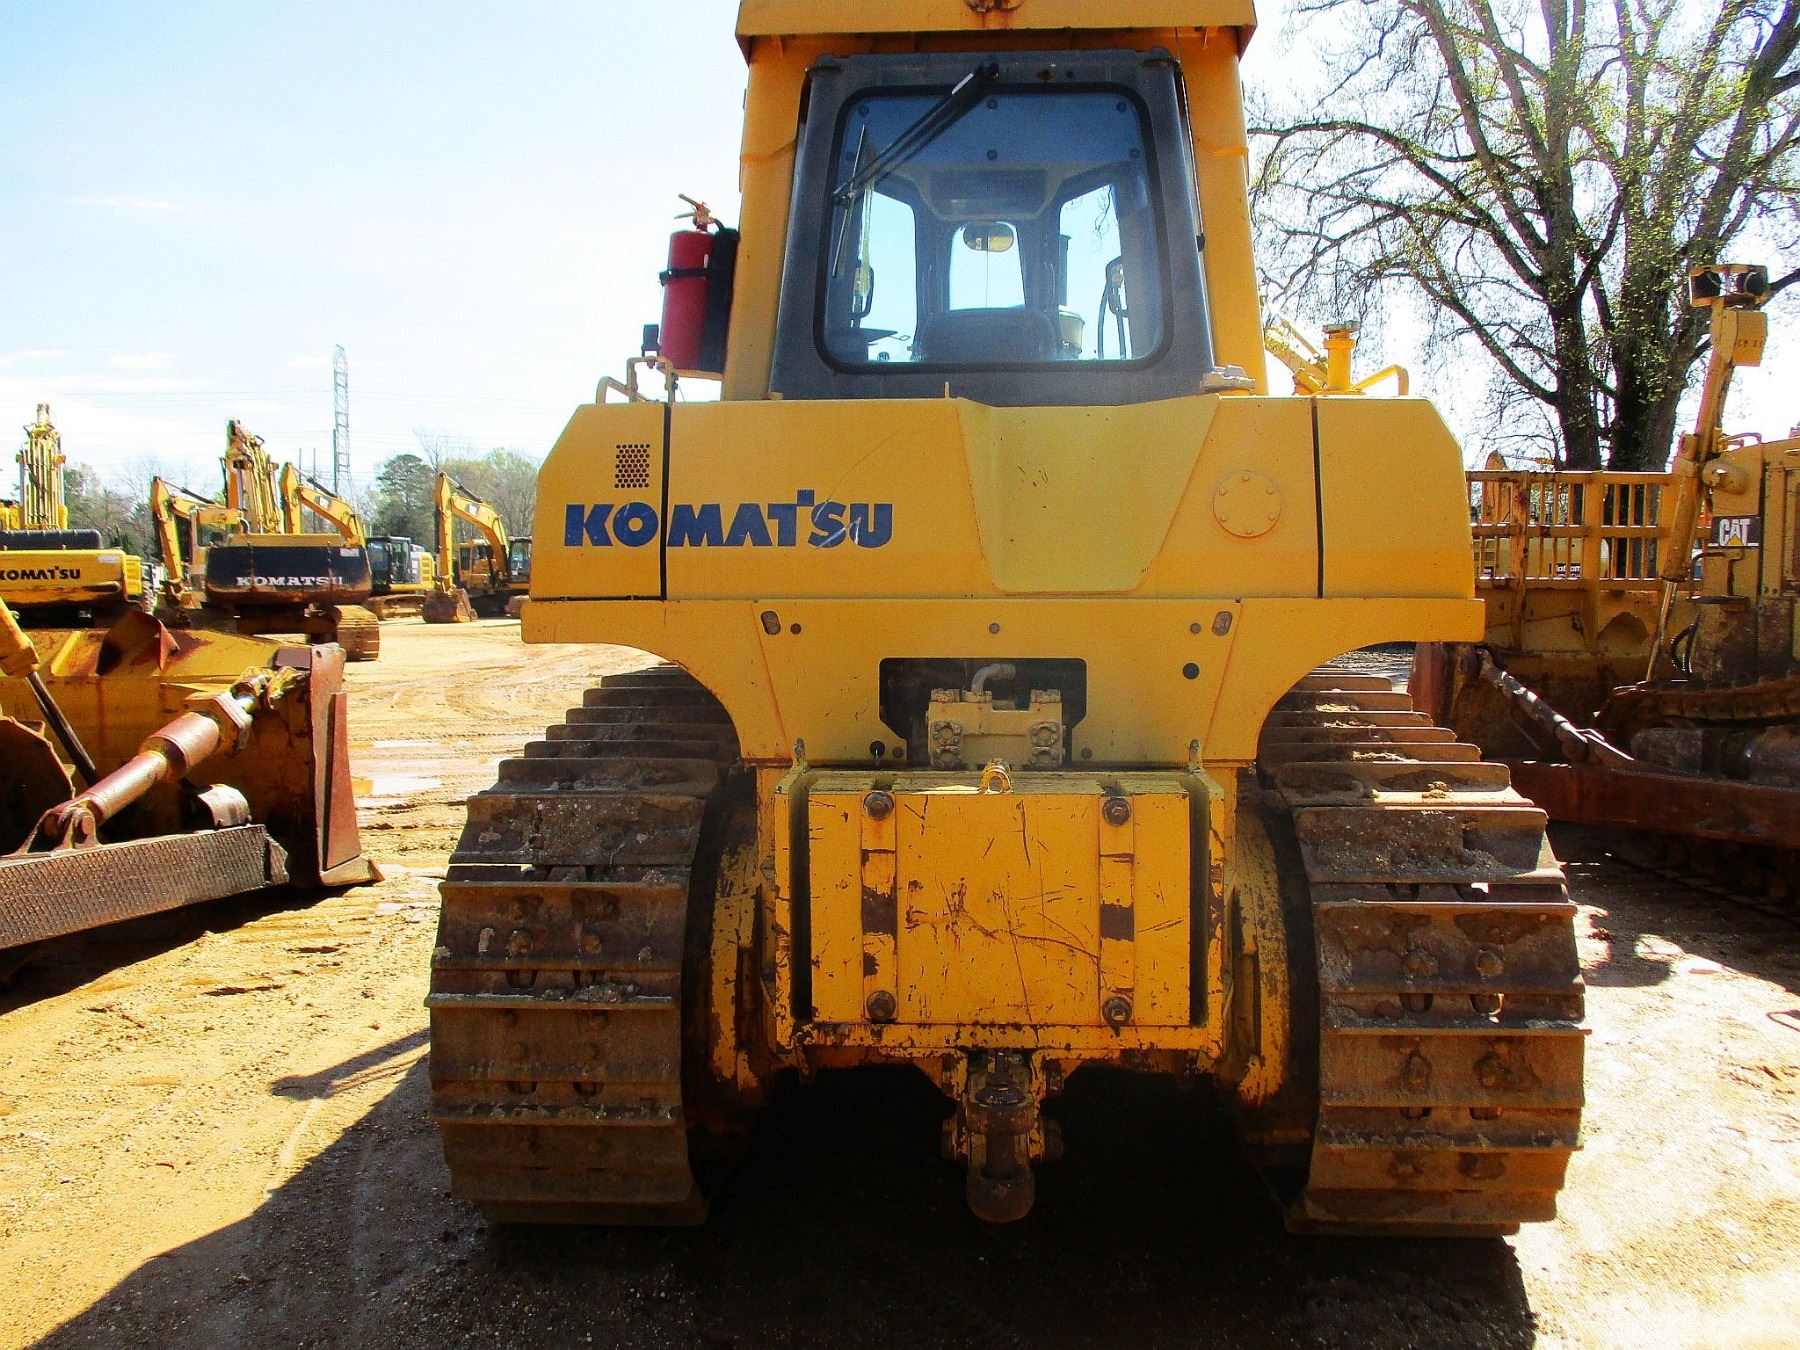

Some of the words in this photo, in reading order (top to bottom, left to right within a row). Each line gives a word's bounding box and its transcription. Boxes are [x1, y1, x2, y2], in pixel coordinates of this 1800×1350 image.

[564, 489, 893, 548] KOMATSU
[1720, 518, 1751, 547] CAT
[236, 576, 343, 586] KOMATSU
